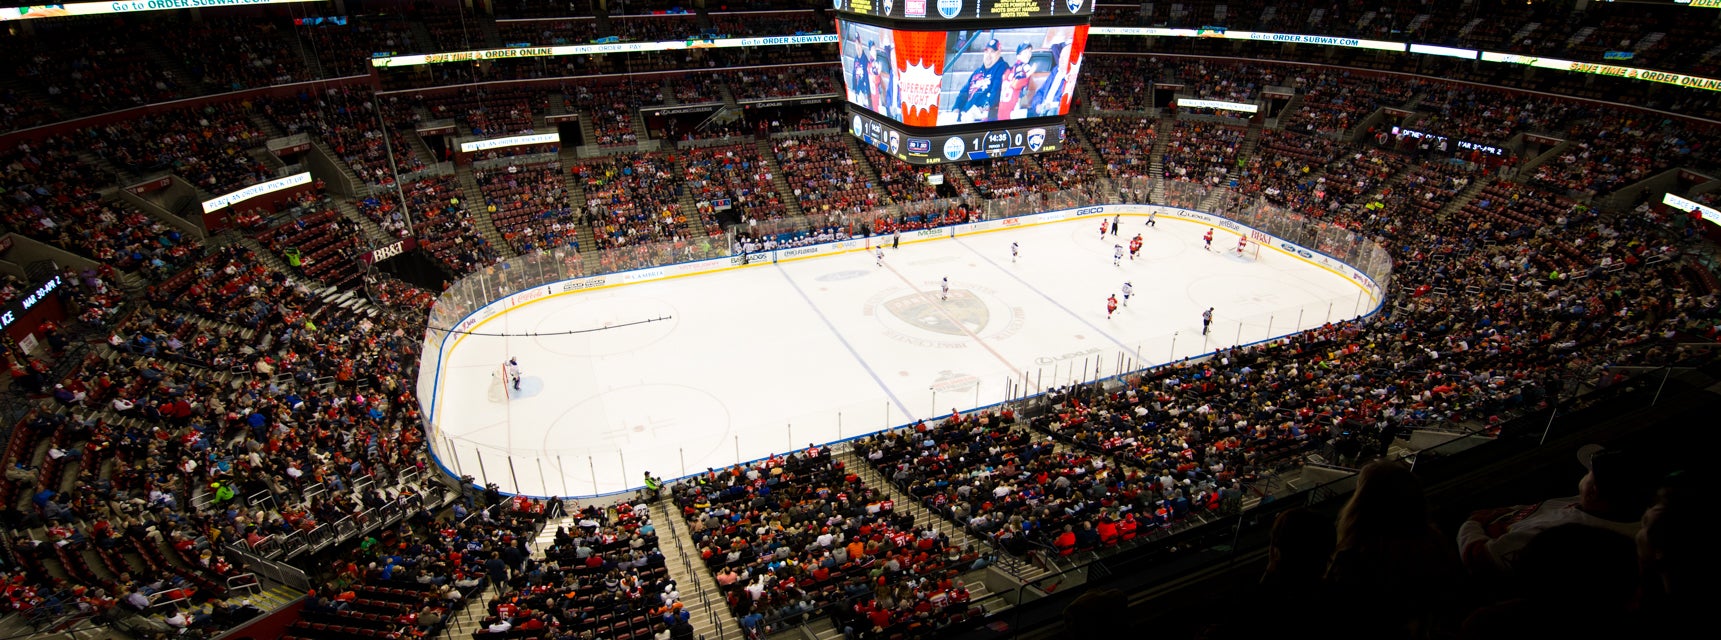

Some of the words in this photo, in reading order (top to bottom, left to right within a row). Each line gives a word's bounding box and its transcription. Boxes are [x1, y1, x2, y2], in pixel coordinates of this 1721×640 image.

[112, 2, 129, 12] Go
[134, 1, 144, 10] to
[742, 38, 752, 46] Go
[1272, 34, 1359, 46] ORDER.SUBWAY.COM
[425, 54, 449, 64] SAVE
[451, 53, 473, 62] TIME
[485, 49, 517, 58] ORDER
[520, 48, 553, 57] ONLINE
[1570, 62, 1597, 73] SAVE
[1599, 65, 1628, 76] TIME
[1629, 69, 1638, 77] &
[1641, 71, 1679, 84] ORDER
[1681, 77, 1721, 90] ONLINE
[900, 81, 940, 95] SUPERHERO
[908, 94, 929, 105] NIGHT
[988, 133, 1007, 142] 14:35
[1015, 133, 1023, 146] 0
[972, 138, 979, 150] 1
[209, 197, 229, 209] PLACE
[232, 193, 241, 201] AN
[242, 186, 264, 198] ORDER
[267, 181, 285, 190] PICK
[294, 175, 304, 183] UP
[1669, 197, 1689, 209] PLACE
[1076, 206, 1104, 216] GEICO
[1188, 213, 1211, 222] LEXUS
[1218, 220, 1240, 232] jetBlue
[917, 228, 943, 237] MOSS
[1251, 230, 1272, 245] BB&T
[373, 240, 404, 263] BB&T
[1, 310, 15, 326] ICE
[22, 294, 37, 310] MAR
[36, 280, 57, 299] 30-APR
[54, 275, 62, 285] 2
[637, 507, 648, 517] 27
